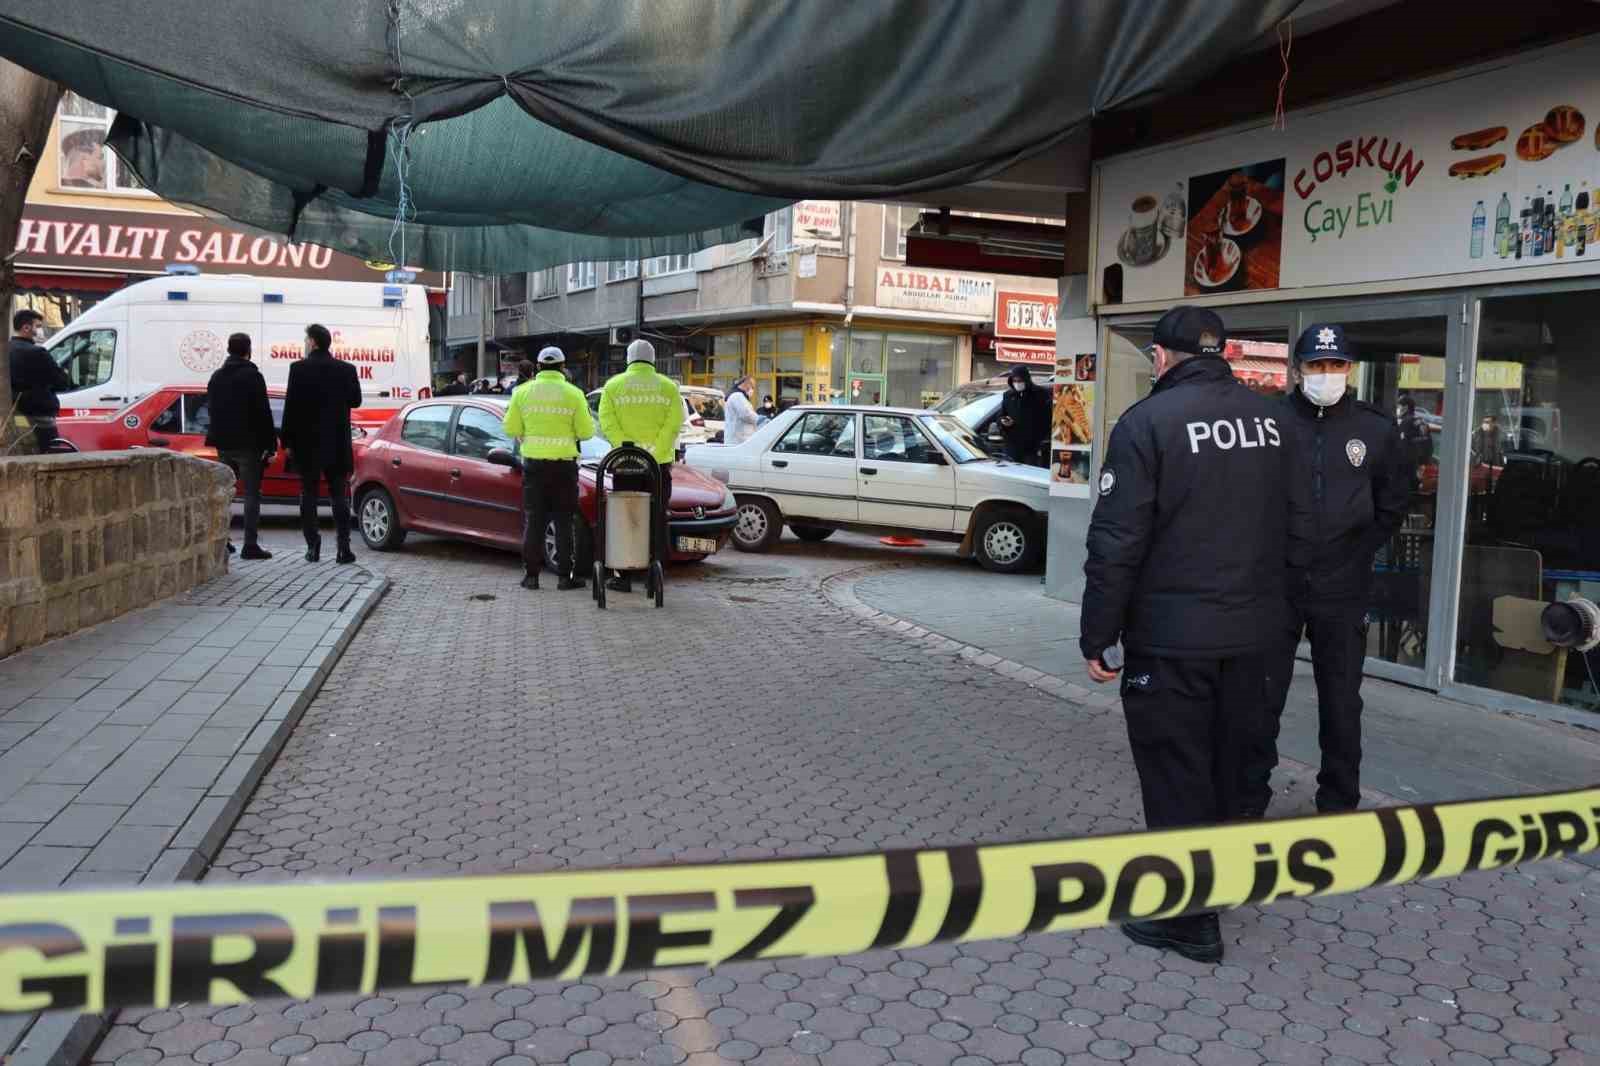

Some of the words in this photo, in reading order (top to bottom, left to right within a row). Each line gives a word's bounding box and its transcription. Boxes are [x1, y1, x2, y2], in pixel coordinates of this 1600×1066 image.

[1294, 136, 1424, 199] COŞKUN
[1304, 200, 1352, 243] Çay
[175, 230, 333, 269] SALONU
[1007, 301, 1056, 329] BEKA
[271, 345, 305, 359] SAĞL
[335, 345, 394, 362] AKANLIĞI
[391, 386, 412, 398] 112
